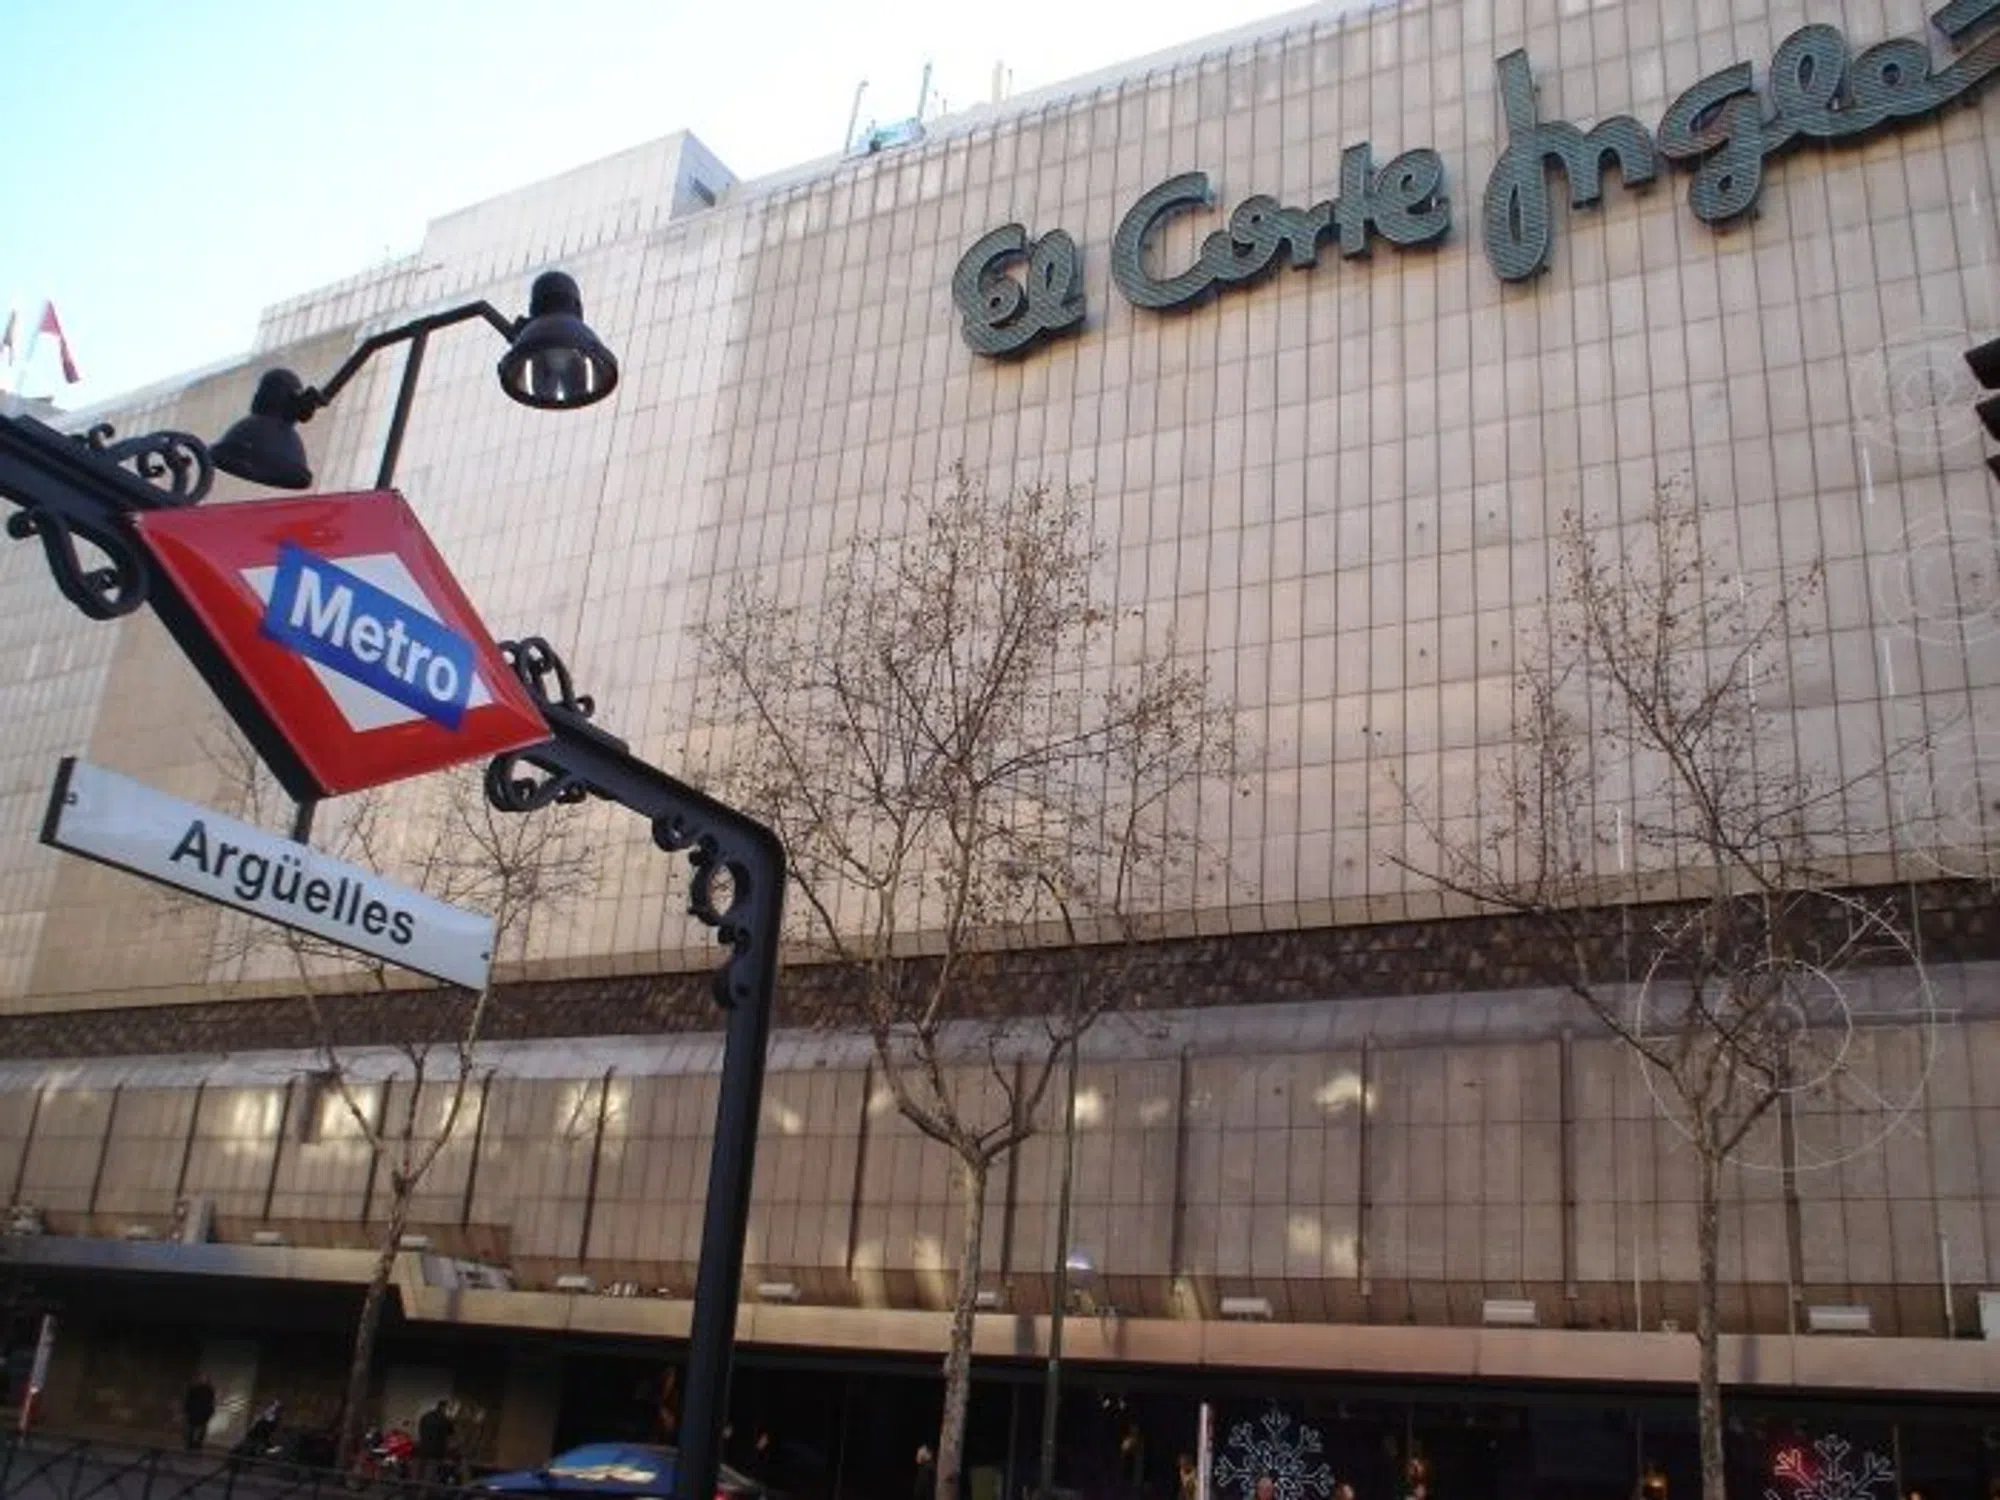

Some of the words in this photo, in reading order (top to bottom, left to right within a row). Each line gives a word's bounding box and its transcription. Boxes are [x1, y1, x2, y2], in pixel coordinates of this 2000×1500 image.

[952, 222, 1086, 357] El
[1112, 141, 1452, 309] Corte
[290, 567, 460, 702] Metro
[170, 820, 416, 945] Argüelles
